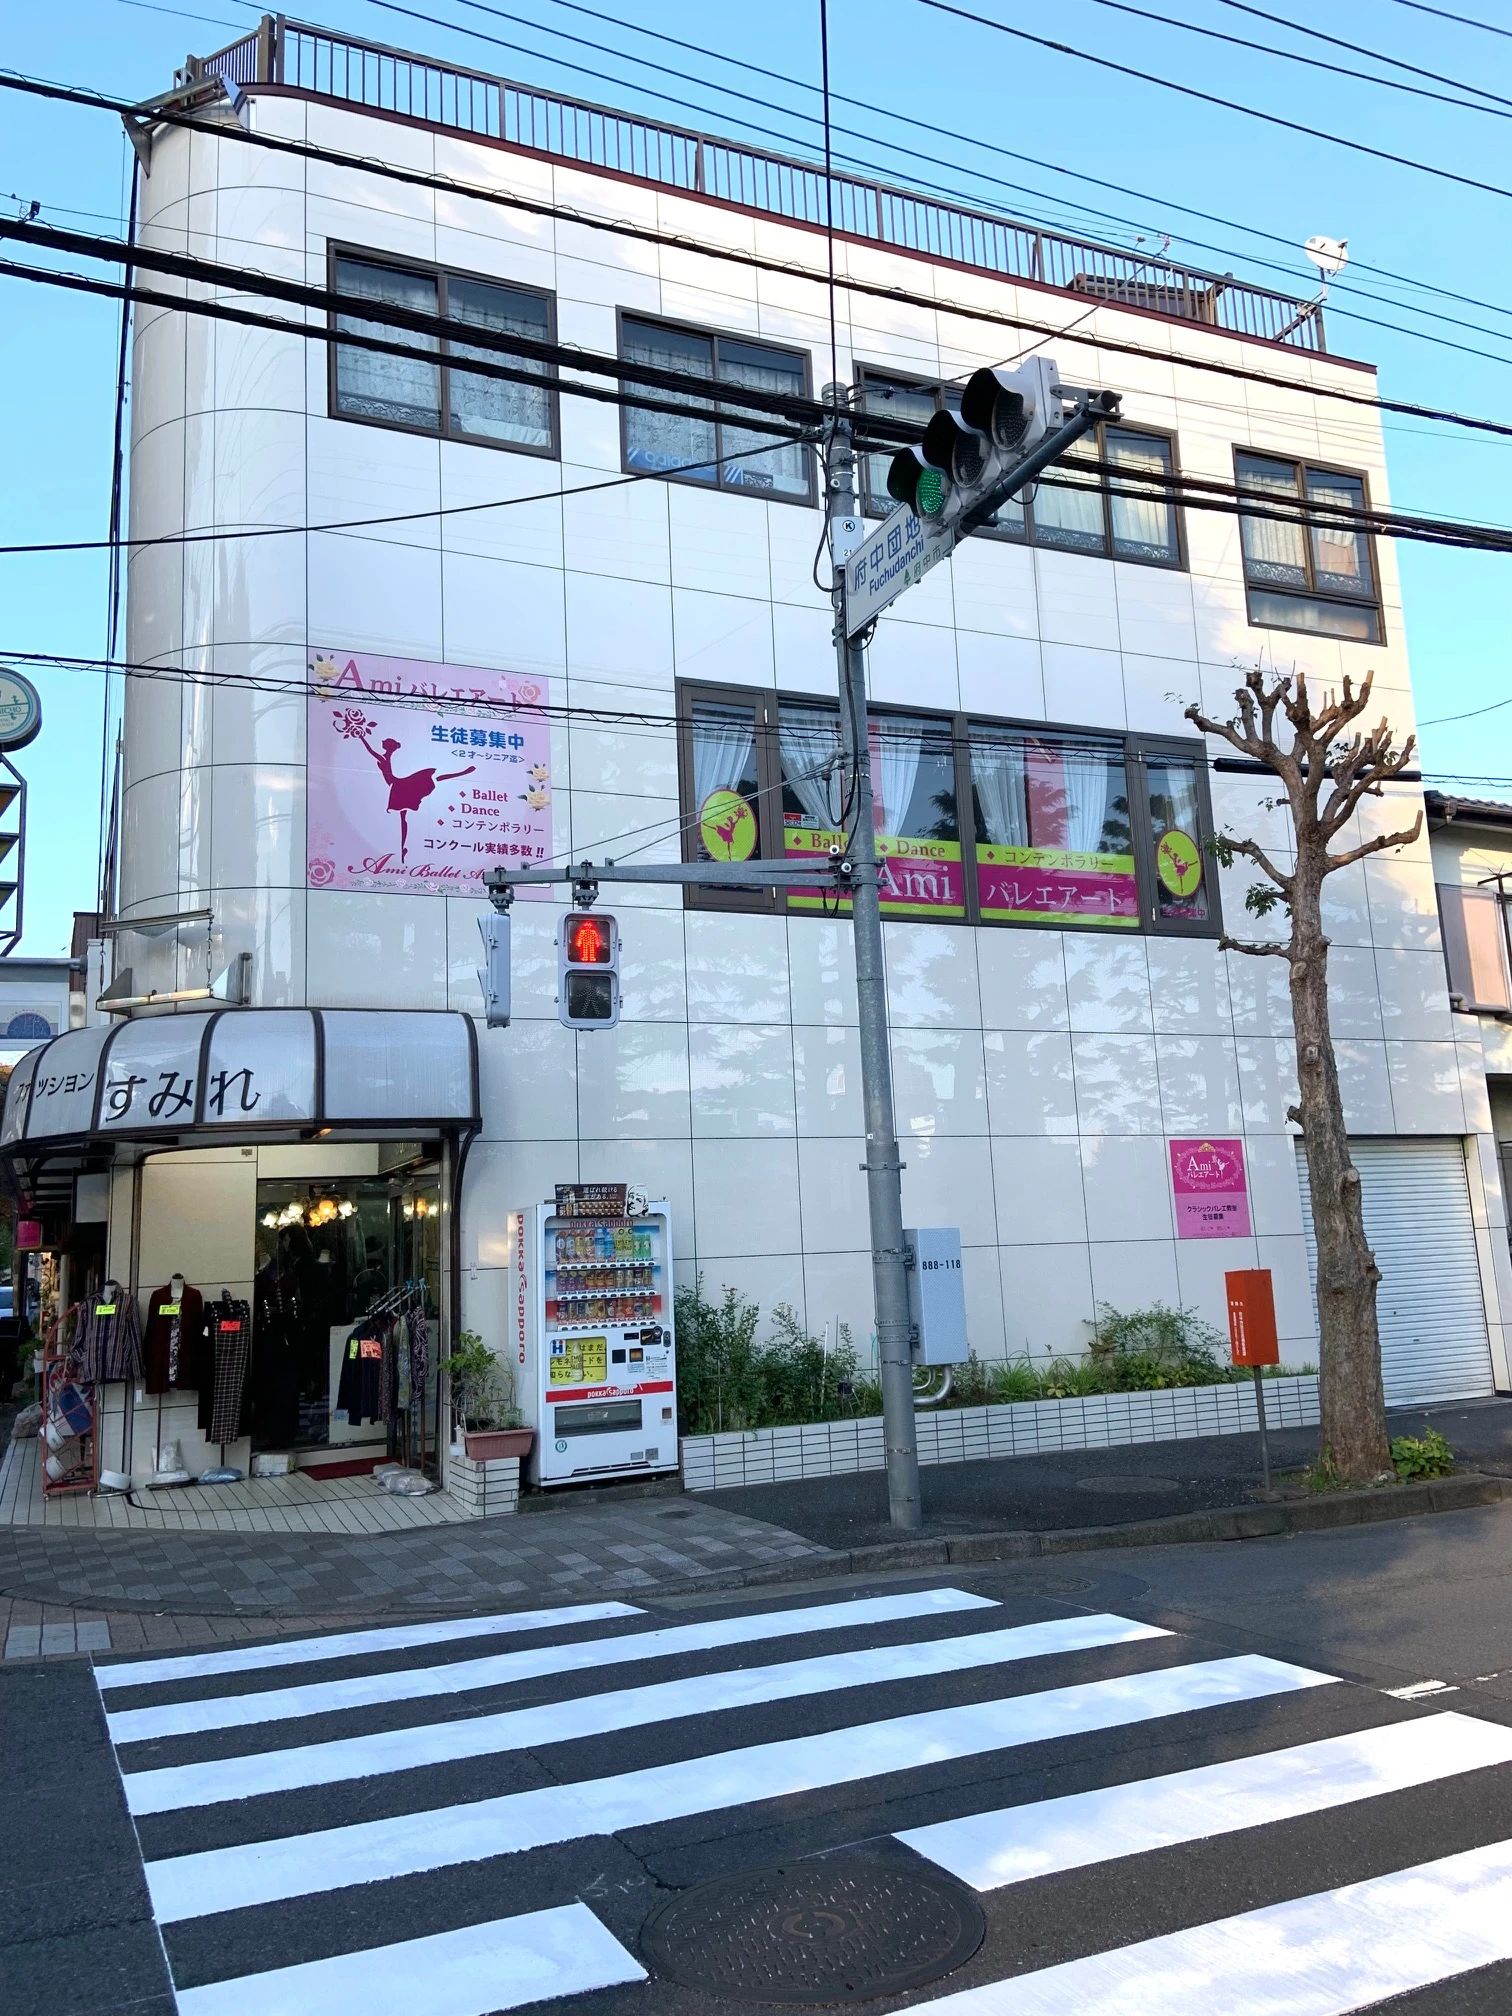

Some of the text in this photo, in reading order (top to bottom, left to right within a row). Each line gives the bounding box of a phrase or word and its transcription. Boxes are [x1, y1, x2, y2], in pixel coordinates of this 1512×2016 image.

[854, 514, 921, 592] 府中団地
[869, 533, 924, 596] Fuchudanchi
[913, 544, 941, 579] 府中市
[334, 659, 402, 693] Ami
[431, 725, 524, 750] 生徒募集中
[472, 789, 508, 802] Ballet
[461, 803, 500, 816] Dance
[452, 820, 545, 834] コンテンポラリー
[897, 840, 945, 858] Dance
[1005, 850, 1114, 870] コンテンポラリー
[347, 853, 408, 874] Ami
[409, 863, 461, 879] Ballet
[877, 863, 953, 900] Ami
[987, 881, 1122, 912] バレエアート
[105, 1068, 261, 1122] すみれ
[1187, 1156, 1212, 1171] Ami
[922, 1259, 961, 1270] 888-118
